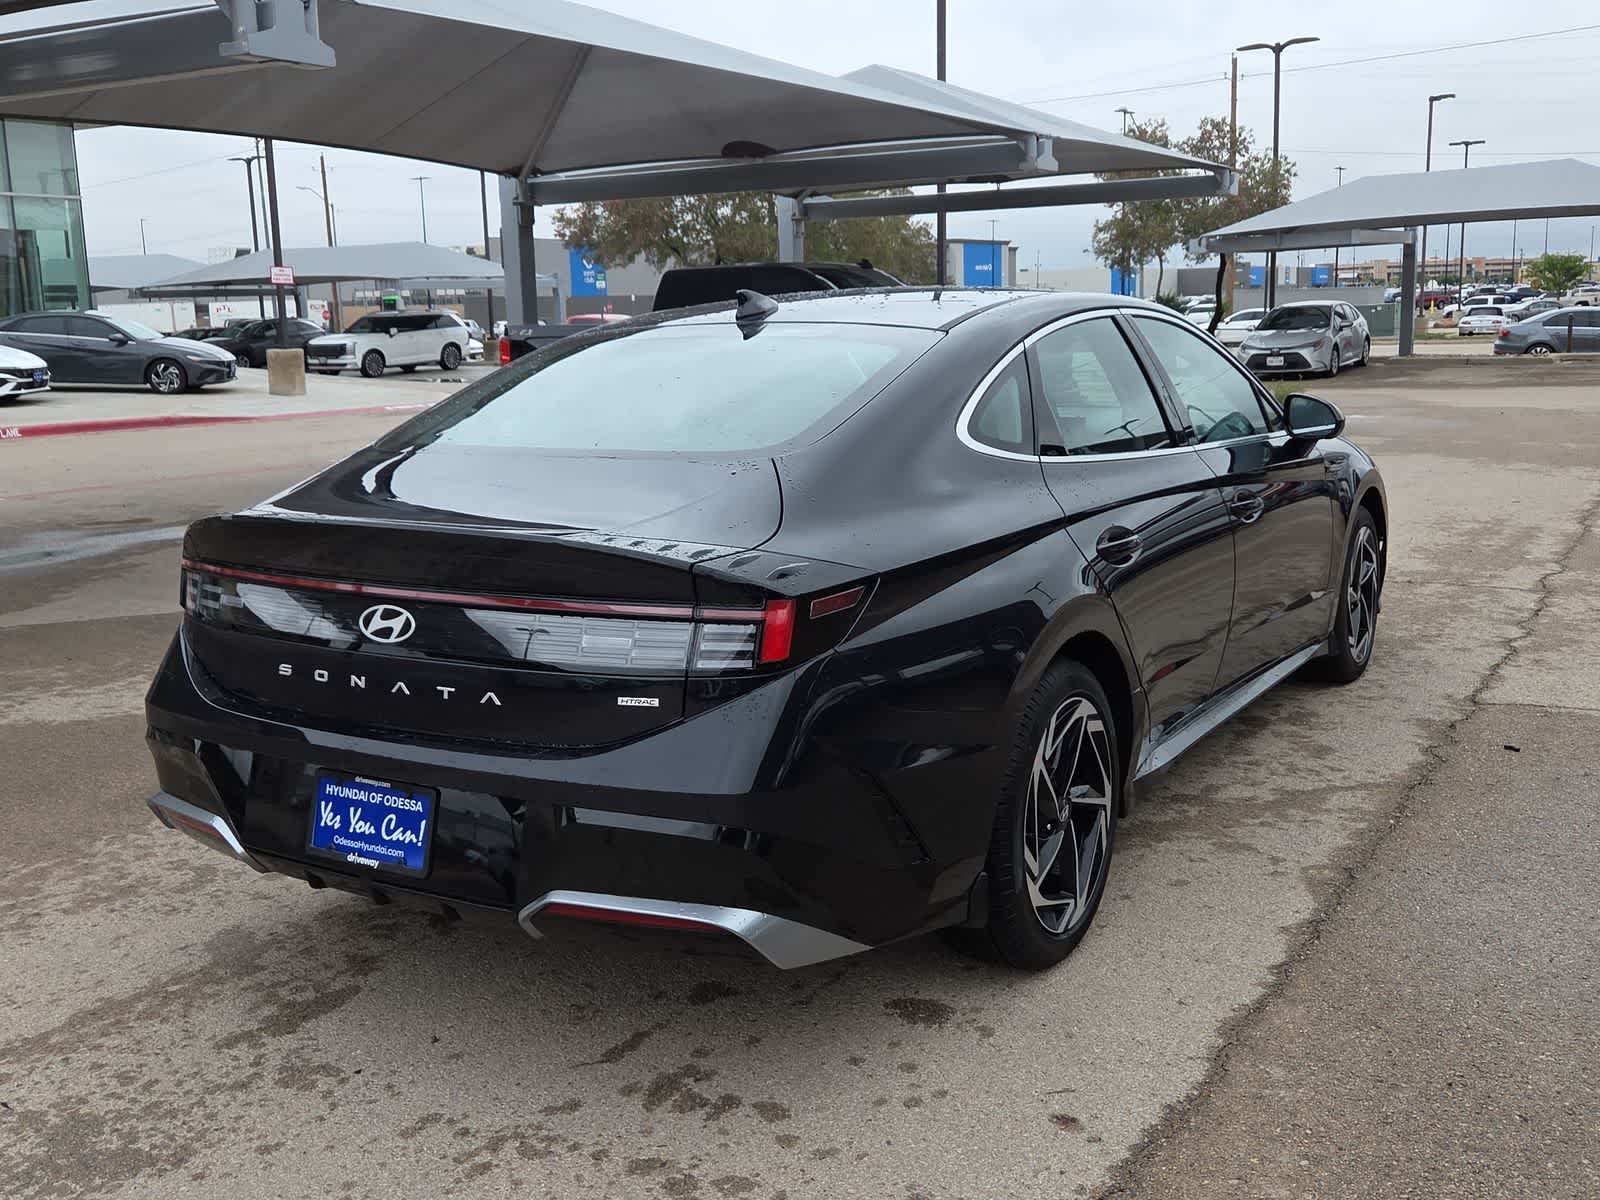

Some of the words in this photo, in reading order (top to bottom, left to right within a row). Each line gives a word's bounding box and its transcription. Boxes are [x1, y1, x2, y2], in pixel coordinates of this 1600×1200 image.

[279, 664, 501, 706] SONATA
[620, 698, 658, 706] HTRAC
[354, 776, 391, 788] driveway.com
[325, 784, 368, 801] HYUNDAI
[369, 792, 384, 804] OF
[384, 795, 423, 812] ODESSA
[320, 801, 341, 829] Yes
[348, 806, 376, 834] You
[381, 813, 426, 846] Can!
[333, 835, 405, 858] OdessaHyundai.com
[347, 852, 379, 869] driveway
